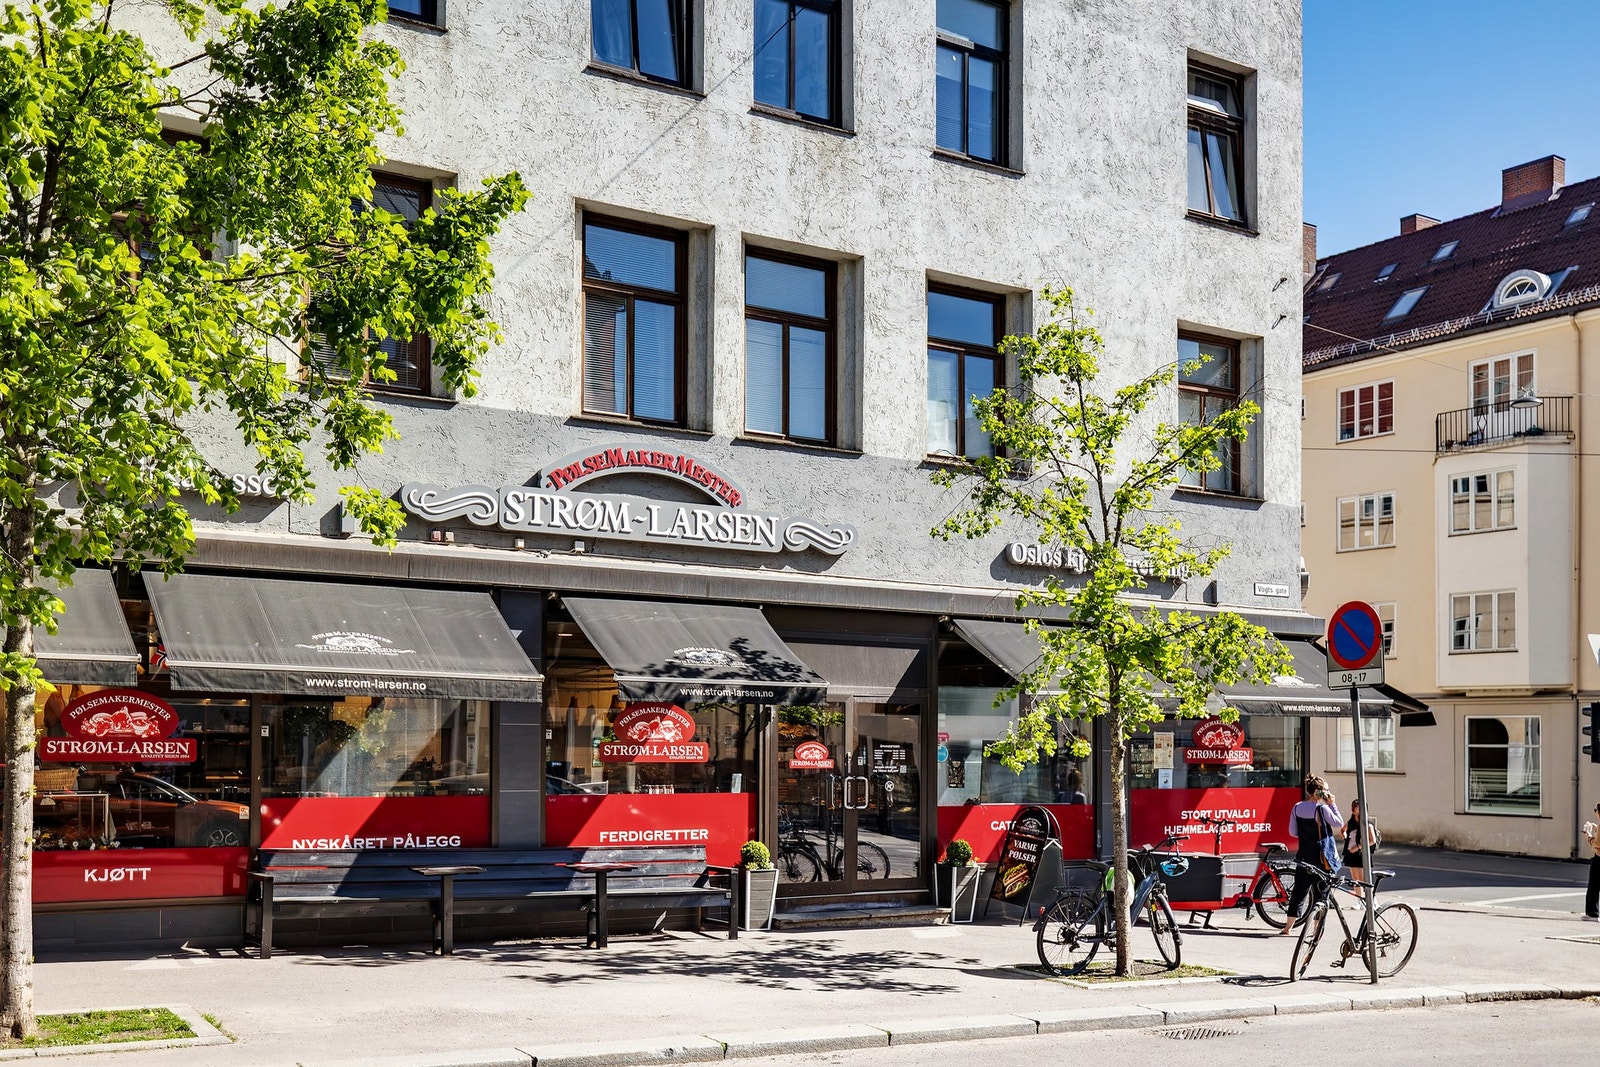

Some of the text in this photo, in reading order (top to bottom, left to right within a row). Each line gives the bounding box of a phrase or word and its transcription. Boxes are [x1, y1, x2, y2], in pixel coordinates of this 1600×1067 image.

[1011, 542, 1062, 568] Oslos
[306, 678, 427, 690] www.strom-larsen.no
[680, 687, 774, 698] www.strom-larsen.no
[69, 695, 171, 720] PØLSEMAKERMESTER
[619, 706, 691, 729] PØLSEMAKERMESTER
[46, 740, 190, 754] STRØM-LARSEN
[603, 744, 704, 756] STRØM-LARSEN
[1186, 749, 1251, 760] STRØM-LARSEN
[1181, 810, 1212, 820] STORT
[1214, 809, 1251, 819] UTVALG
[599, 828, 709, 842] FERDIGRETTER
[1236, 823, 1271, 833] PØLSER
[291, 833, 461, 849] NYSKÅRET PÅLEGG
[1013, 840, 1038, 852] VARME
[1008, 849, 1037, 863] PØLSER
[84, 867, 151, 882] KJØTT
